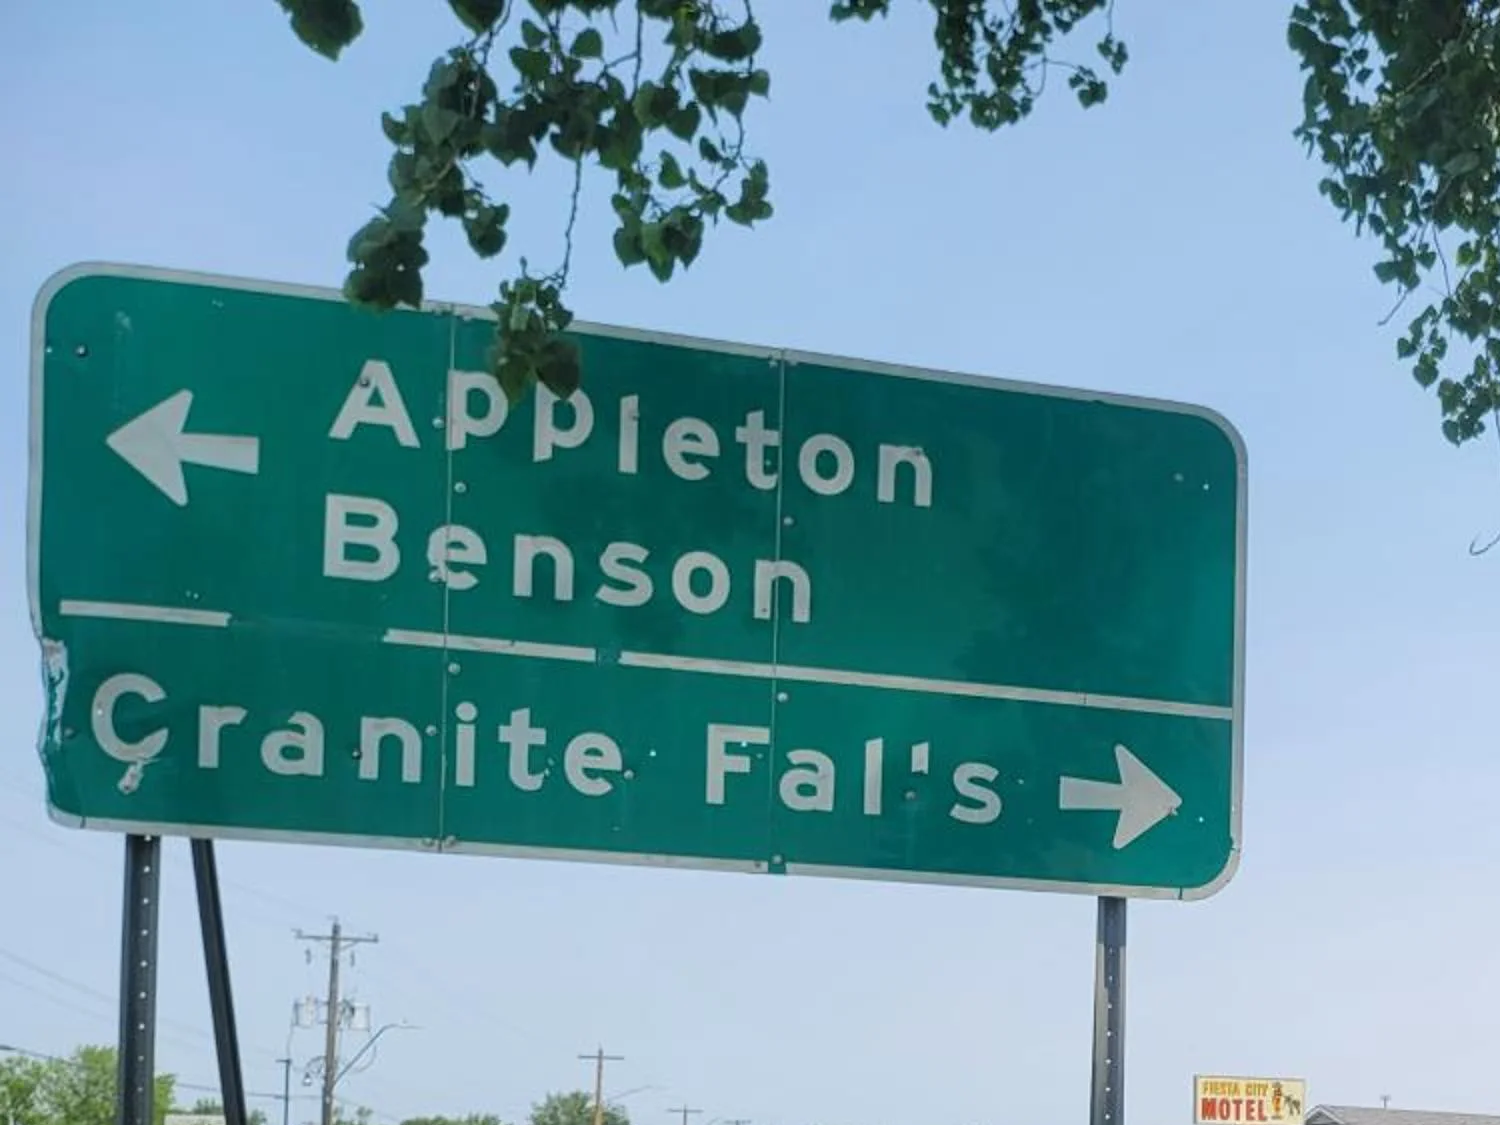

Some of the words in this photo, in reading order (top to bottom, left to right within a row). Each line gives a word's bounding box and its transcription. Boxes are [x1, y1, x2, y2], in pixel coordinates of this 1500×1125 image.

[329, 359, 933, 508] Appleton
[322, 493, 811, 623] Benson
[1201, 1097, 1268, 1122] MOTEL
[1202, 1081, 1241, 1096] FIESTA
[1245, 1082, 1269, 1097] CITY
